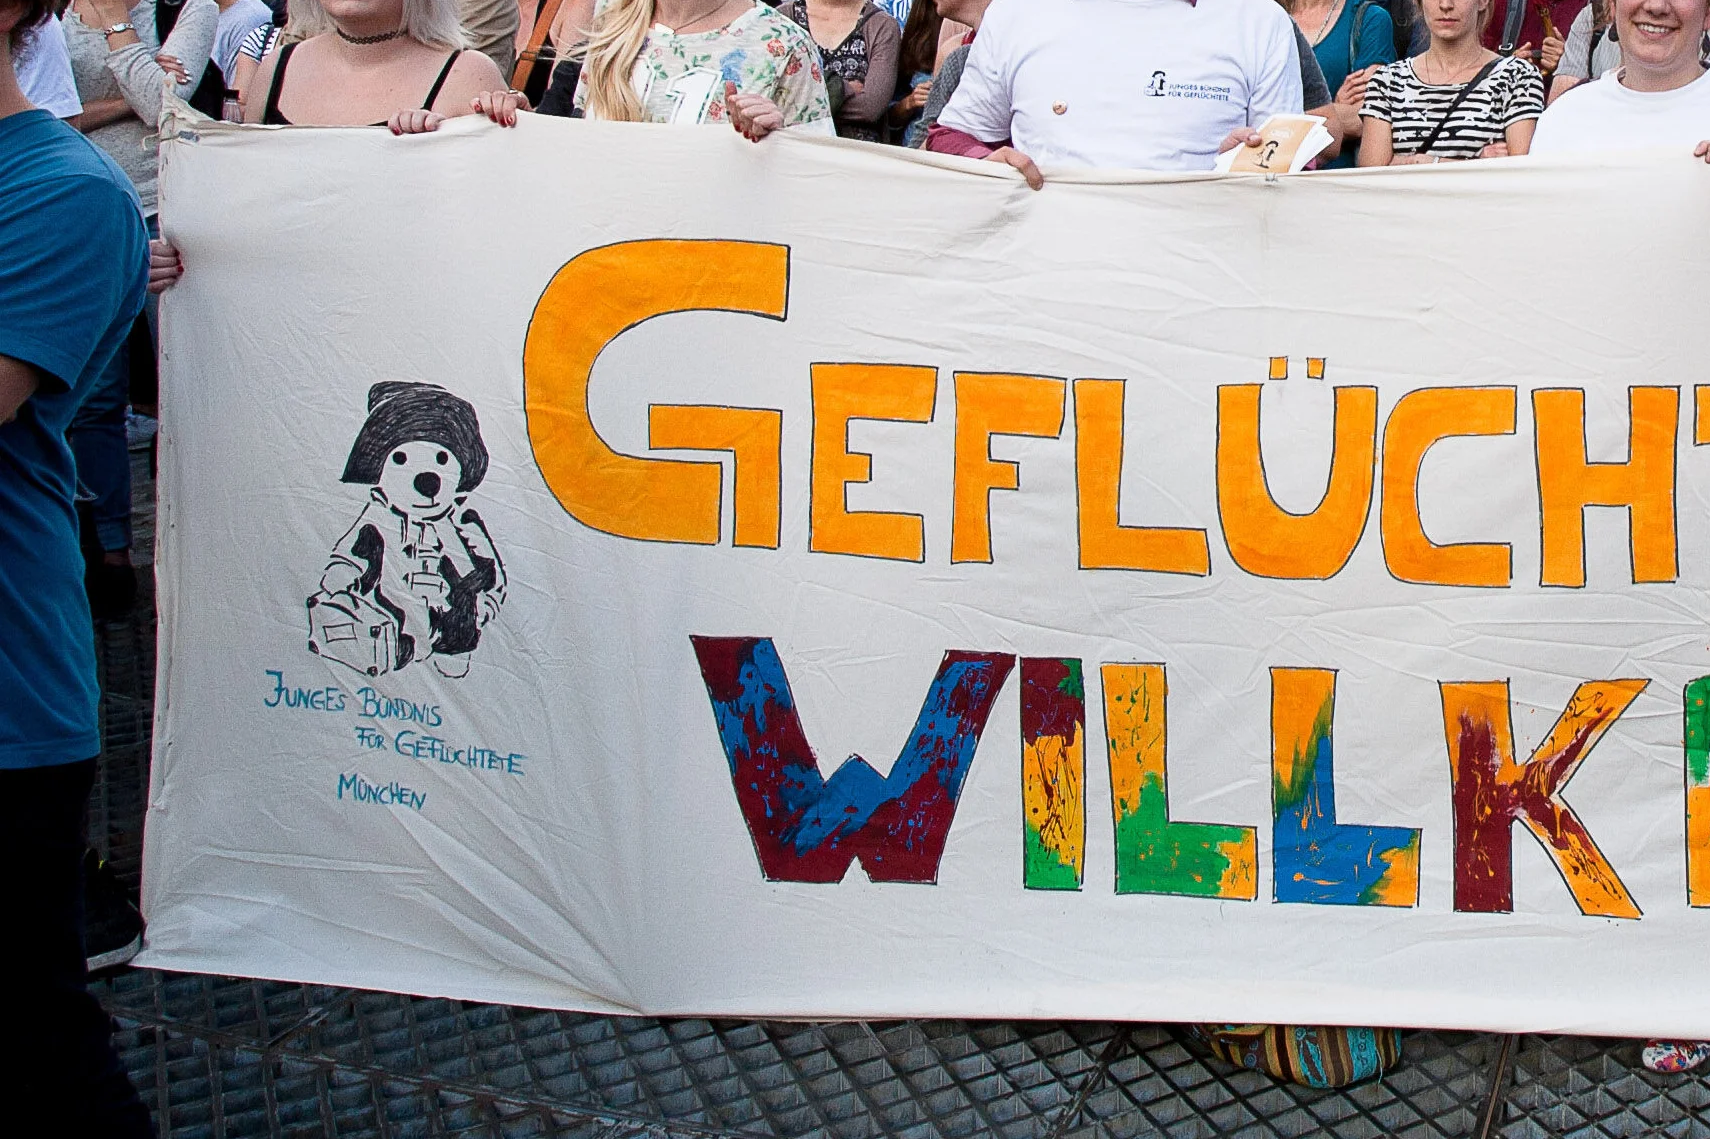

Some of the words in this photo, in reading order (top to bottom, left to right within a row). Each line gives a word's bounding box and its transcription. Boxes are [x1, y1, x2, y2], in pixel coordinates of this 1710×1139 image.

[1183, 91, 1229, 101] GEFLÜCHTETE
[263, 668, 349, 712] JUNGES
[356, 686, 442, 726] BÜNDNIS
[336, 772, 427, 810] MÜNCHEN
